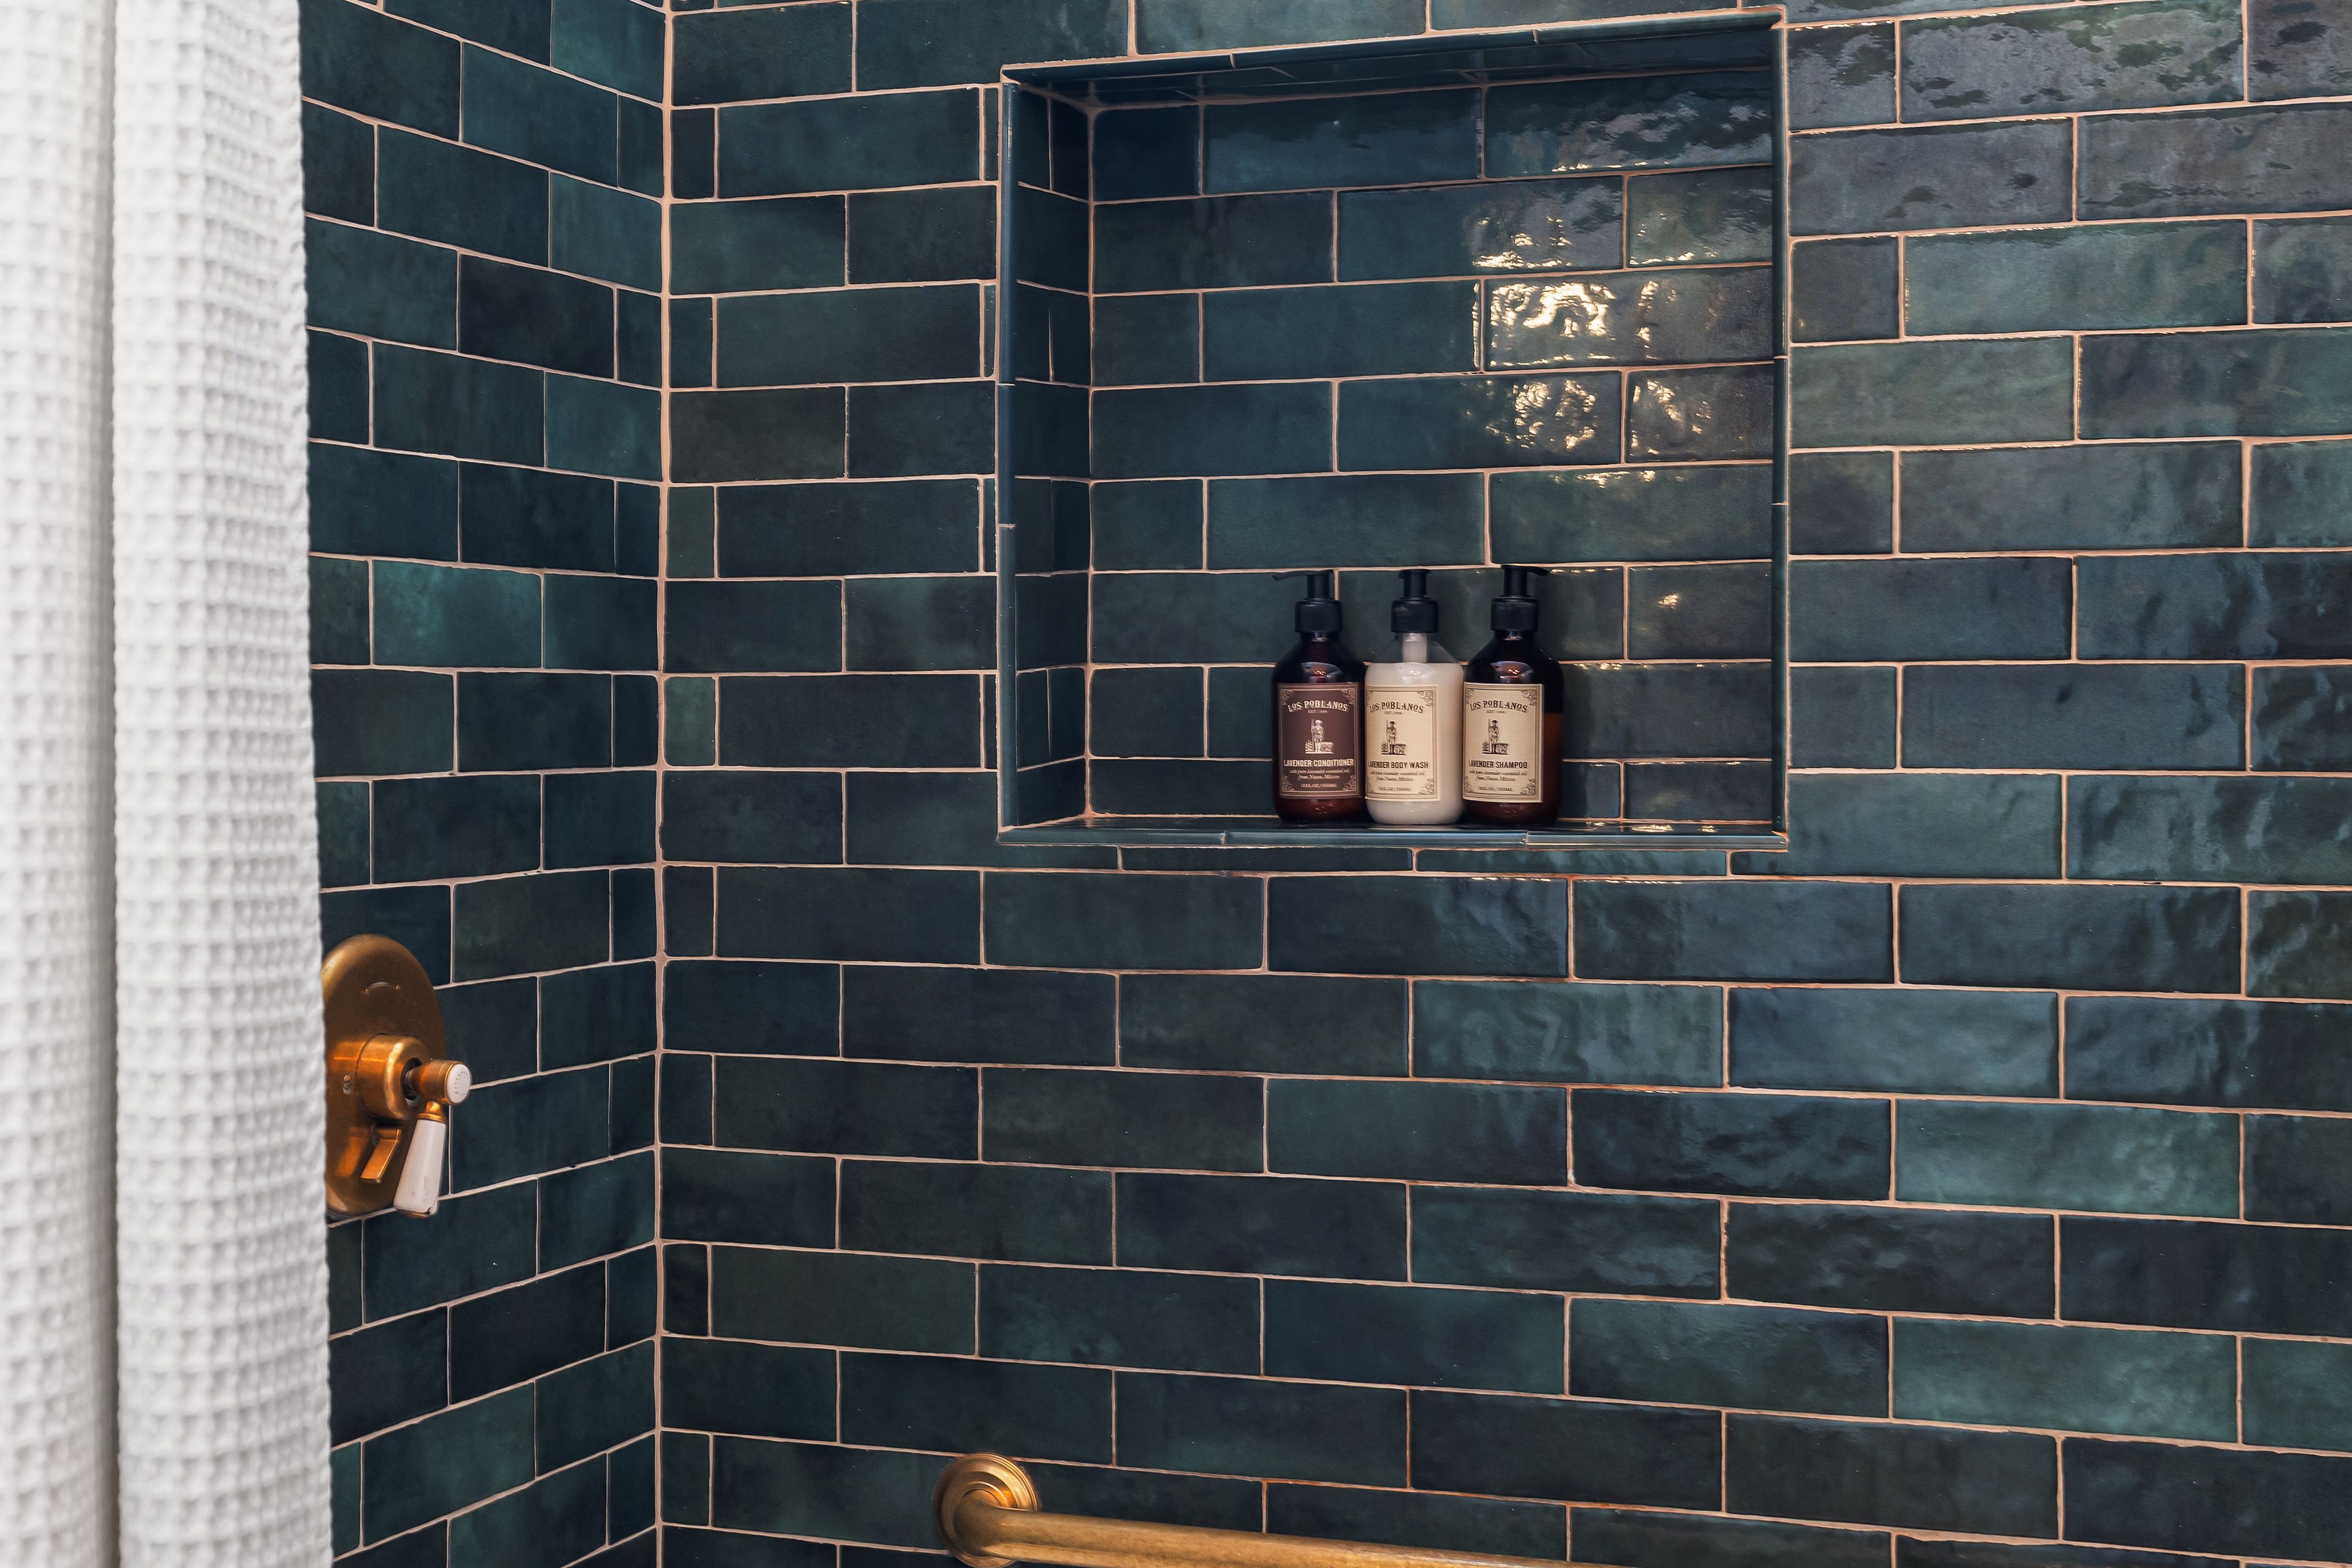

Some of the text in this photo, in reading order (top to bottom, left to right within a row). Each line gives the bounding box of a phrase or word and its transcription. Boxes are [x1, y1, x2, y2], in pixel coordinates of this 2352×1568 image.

[1287, 701, 1302, 712] LOS
[1313, 758, 1354, 767] CONDITIONER
[1468, 760, 1494, 768] LAVENDER
